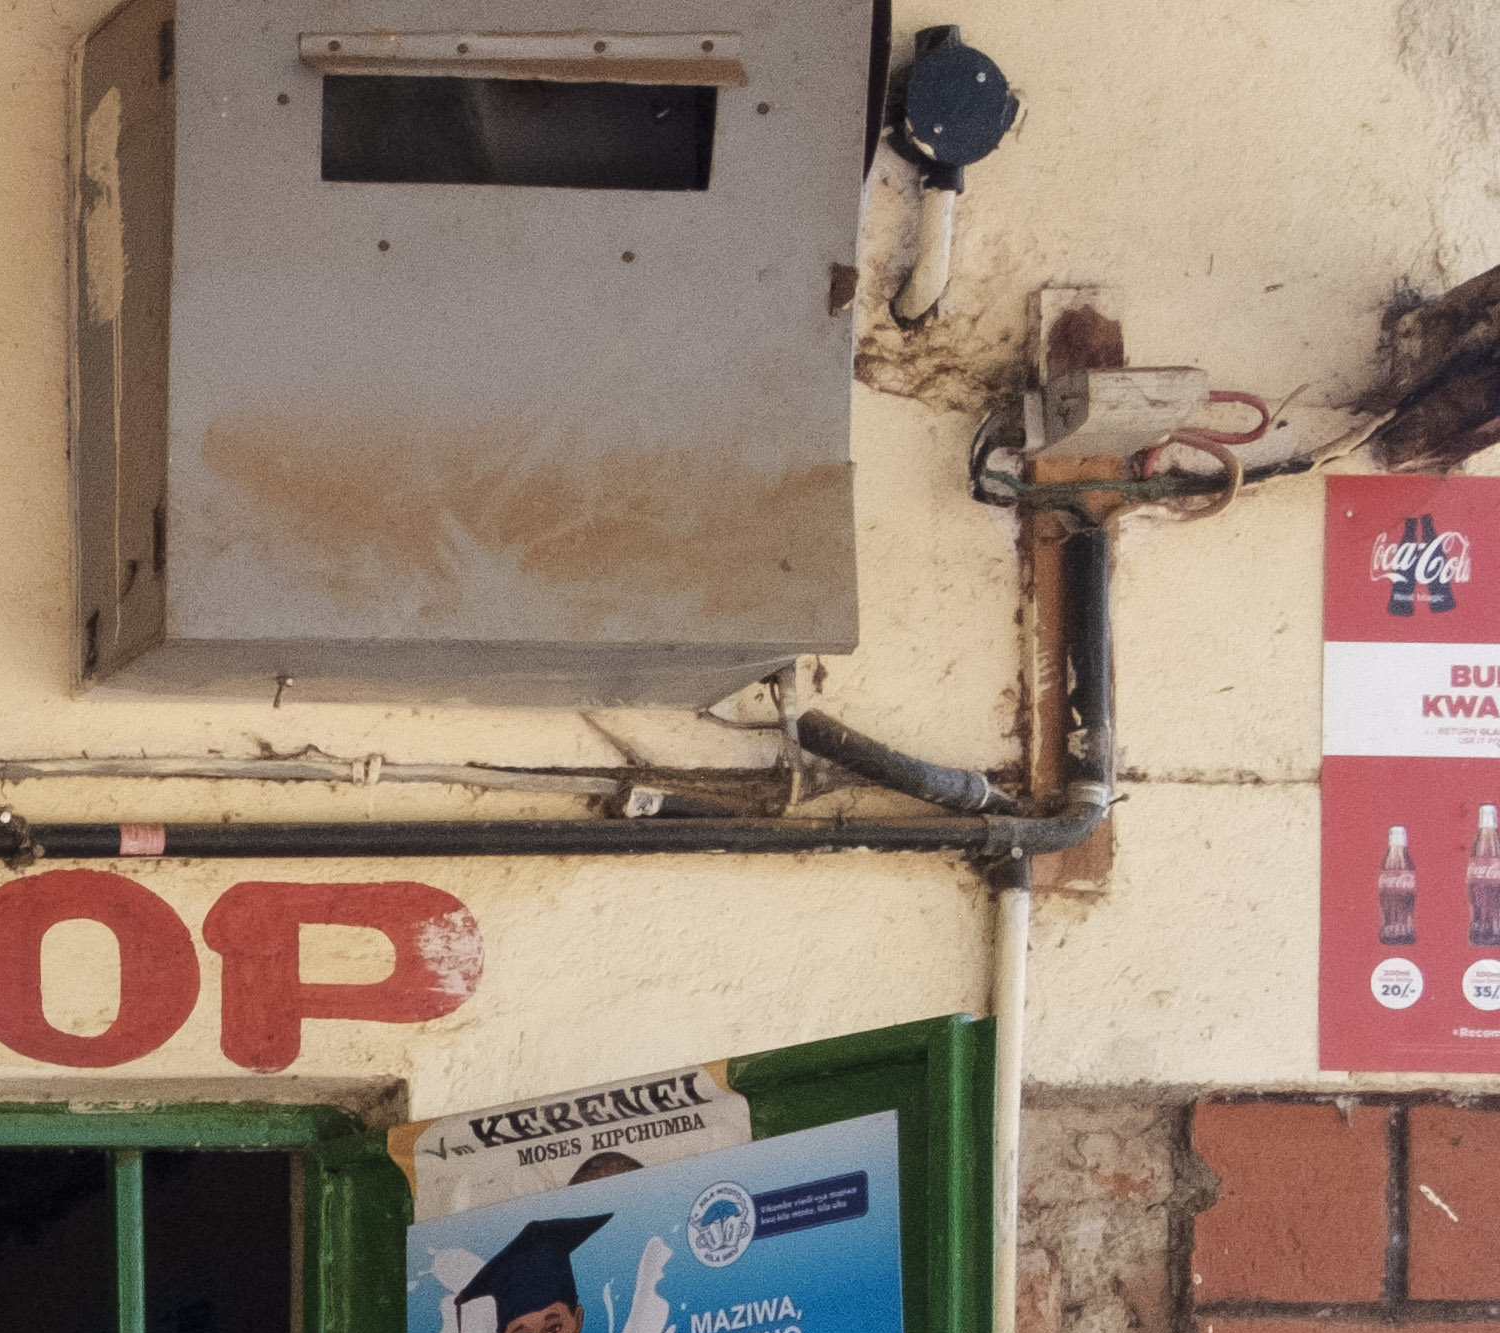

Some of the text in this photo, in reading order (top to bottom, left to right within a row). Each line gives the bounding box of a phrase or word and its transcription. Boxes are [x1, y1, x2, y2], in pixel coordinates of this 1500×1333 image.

[1370, 531, 1471, 585] Coca-Cola
[1450, 664, 1500, 688] BU
[516, 1138, 582, 1167] MOSES
[591, 1113, 706, 1151] KIPCHUMBA
